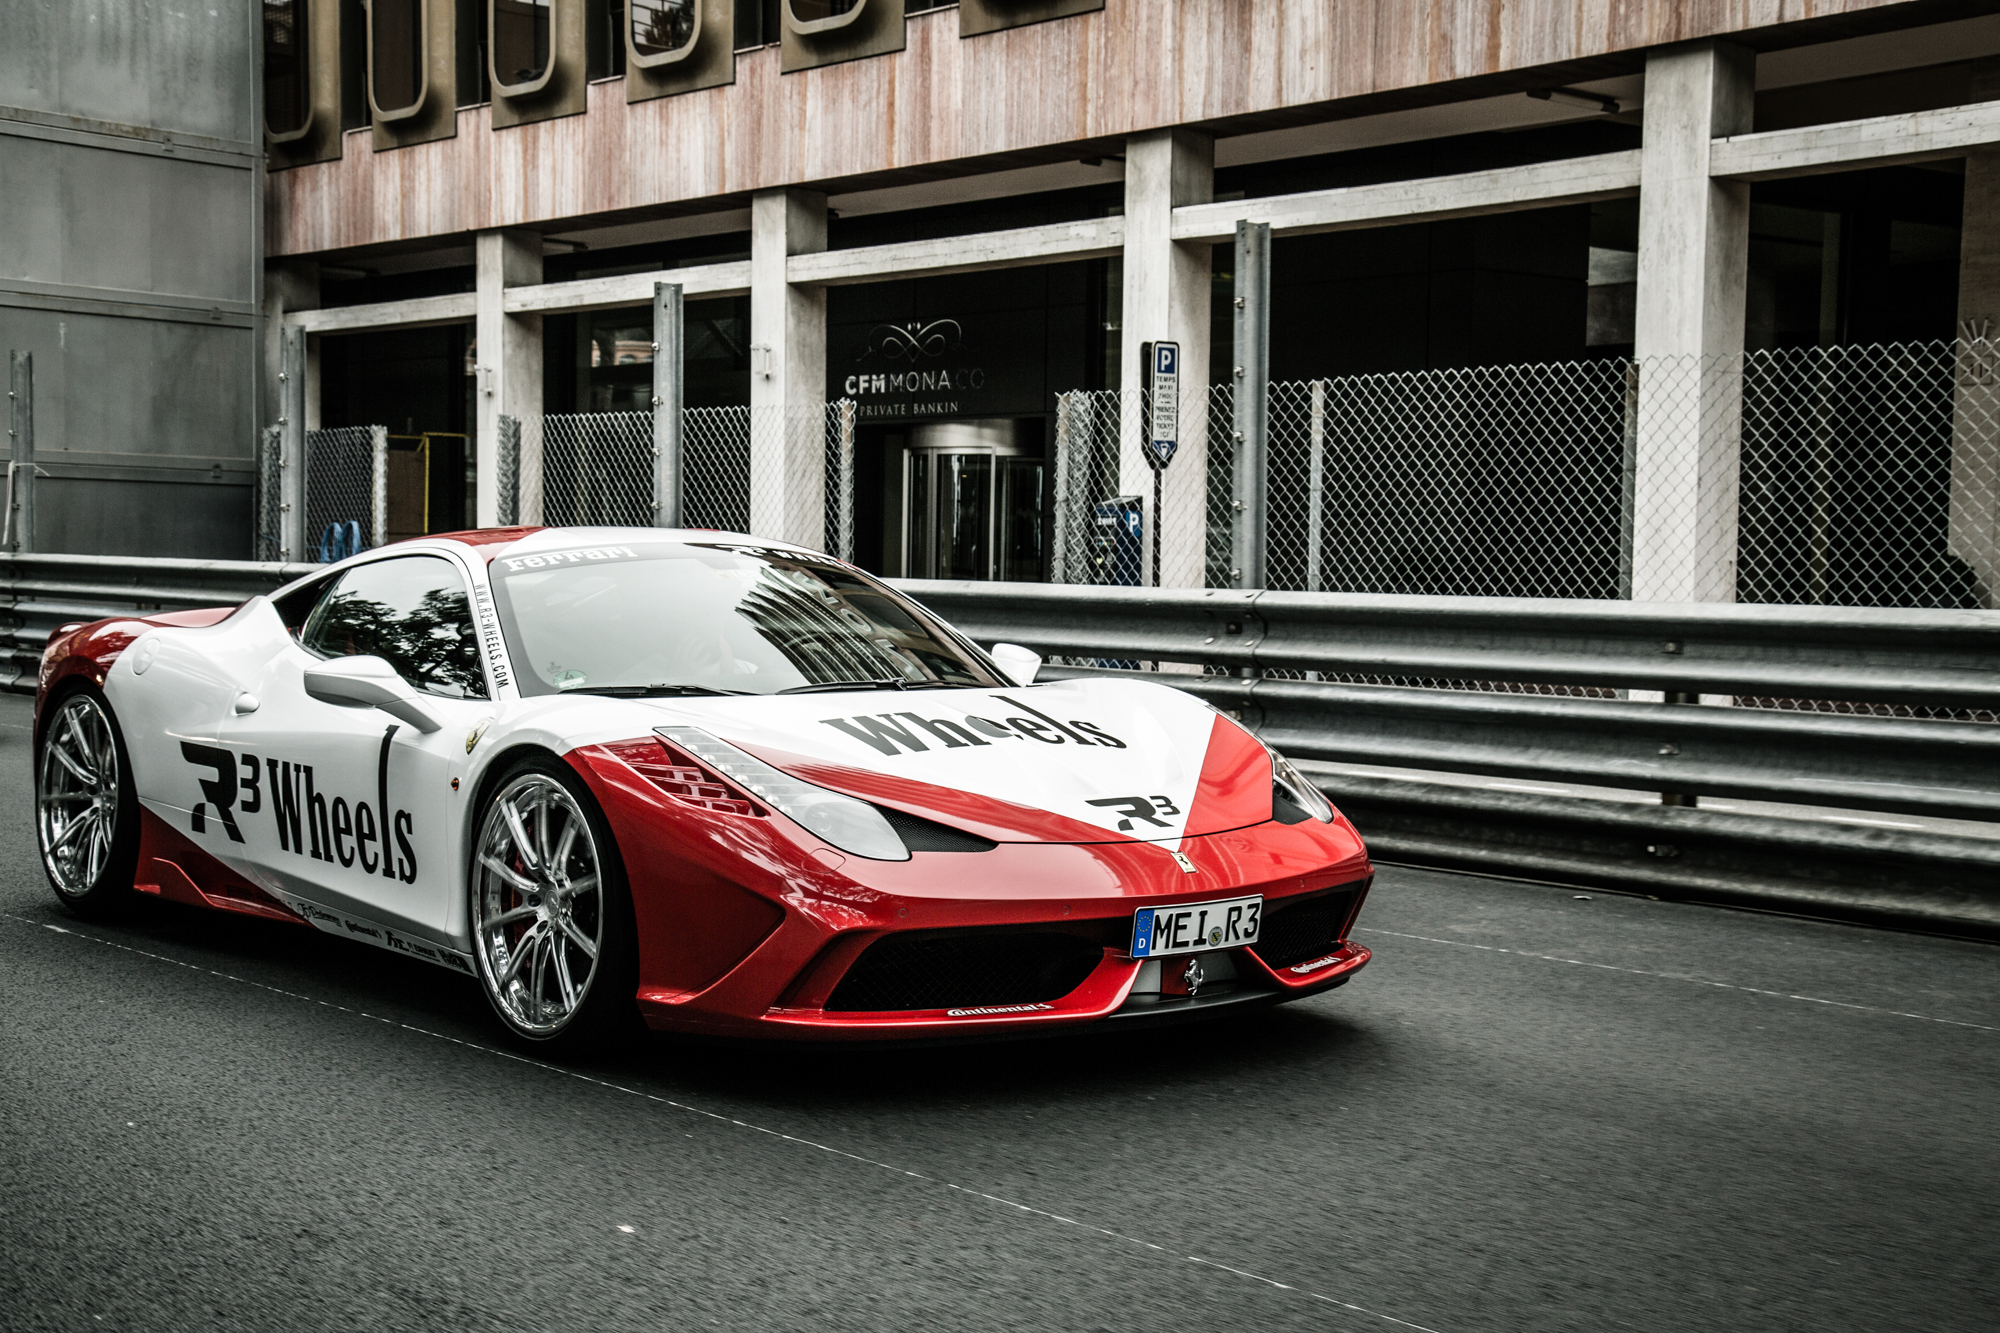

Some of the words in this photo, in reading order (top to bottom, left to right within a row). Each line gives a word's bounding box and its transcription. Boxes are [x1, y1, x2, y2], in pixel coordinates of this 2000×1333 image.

[1161, 349, 1172, 371] P
[845, 373, 885, 395] CFM
[889, 368, 984, 393] MONACO
[1156, 375, 1176, 383] TEMPS
[859, 403, 906, 416] PRIVATE
[1129, 513, 1139, 533] P
[501, 546, 638, 572] Ferrari
[474, 582, 509, 689] WWW.R3-WHEELS.COM
[818, 694, 1127, 757] Wheels
[266, 724, 417, 885] Wheels
[1138, 938, 1146, 949] D
[1151, 910, 1208, 950] MEI
[1224, 902, 1260, 942] R3
[947, 1004, 1040, 1017] Continental
